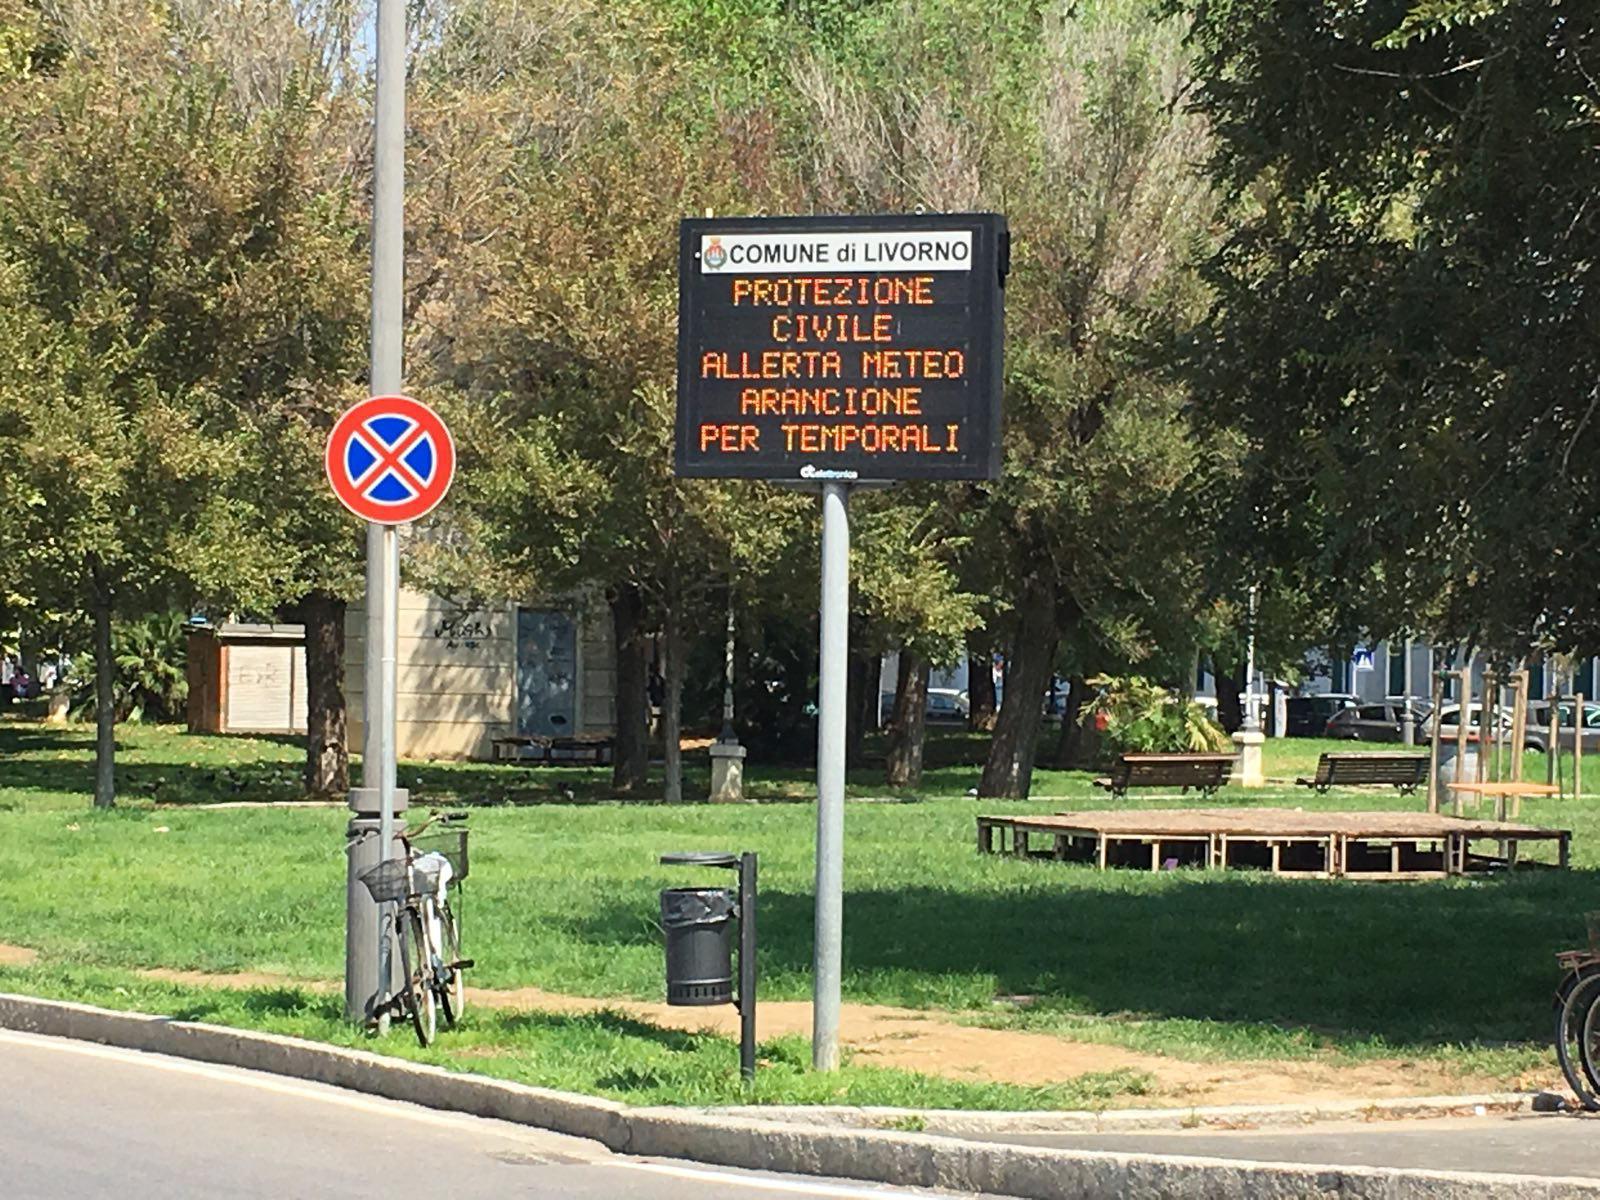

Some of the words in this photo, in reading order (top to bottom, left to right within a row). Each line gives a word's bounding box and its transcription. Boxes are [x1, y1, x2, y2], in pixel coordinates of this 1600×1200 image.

[729, 244, 829, 264] COMUNE
[837, 244, 856, 262] di
[864, 241, 969, 262] LIVORNO
[733, 277, 934, 306] PROTEZIONE
[772, 314, 893, 342] CIVILE
[701, 351, 841, 379] ALLERTA
[862, 350, 964, 379] METEO
[740, 387, 923, 415] ARANCIONE
[701, 424, 760, 452] PER
[781, 423, 959, 452] TEMPORALI
